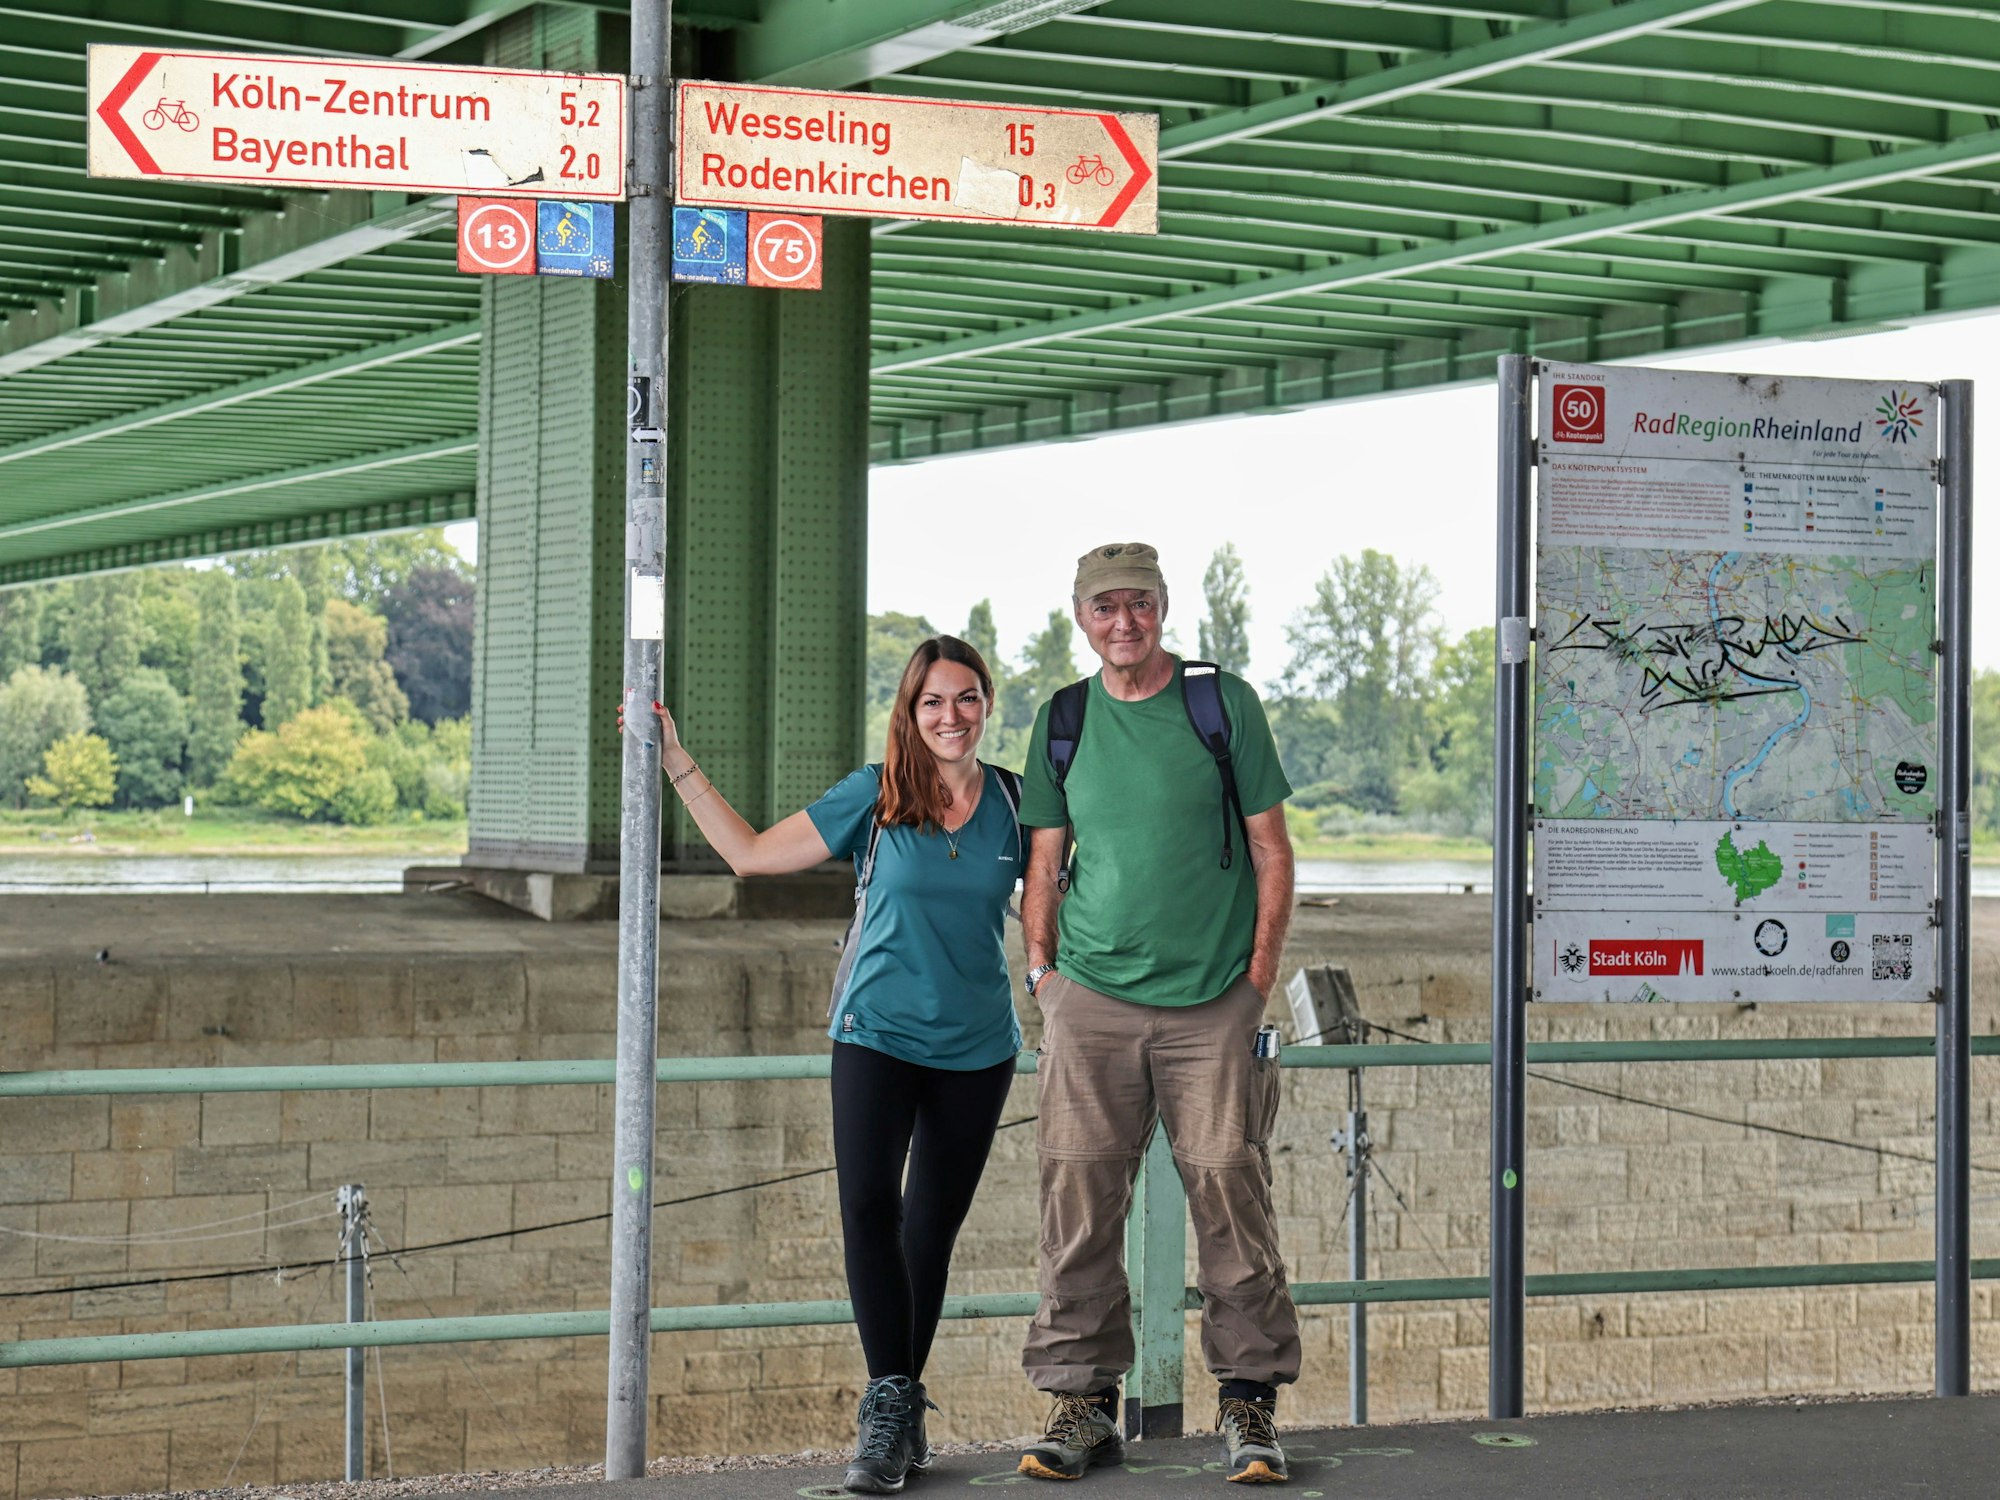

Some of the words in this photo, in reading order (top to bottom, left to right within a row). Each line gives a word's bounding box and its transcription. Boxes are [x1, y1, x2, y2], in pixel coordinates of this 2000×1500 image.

[213, 73, 490, 121] Köln-Zentrum
[560, 93, 599, 129] 5,2
[704, 101, 891, 154] Wesseling
[1005, 123, 1034, 157] 15
[213, 127, 409, 173] Bayenthal
[560, 146, 599, 180] 2,0
[702, 154, 950, 202] Rodenkirchen
[1019, 175, 1056, 211] 0,3
[477, 224, 517, 249] 13
[765, 238, 804, 264] 75
[539, 267, 583, 276] Rheinradweg
[593, 261, 607, 272] 15
[727, 268, 741, 279] 15
[1553, 372, 1565, 380] IHR
[1567, 373, 1605, 382] STANDORT
[1567, 401, 1591, 418] 50
[1634, 411, 1862, 443] RadRegionRheinland
[1566, 431, 1603, 441] Knotenpunkt
[1552, 463, 1566, 471] DAS
[1568, 464, 1648, 474] KNOTENPUNKTSYSTEM
[1759, 472, 1815, 481] THEMENROUTEN
[1826, 475, 1847, 483] RAUM
[1561, 827, 1639, 835] RADREGIONRHEINLAND
[1592, 951, 1631, 967] Stadt
[1635, 950, 1667, 966] Köln
[1711, 964, 1864, 978] www.stadtkoeln.de/radfahren
